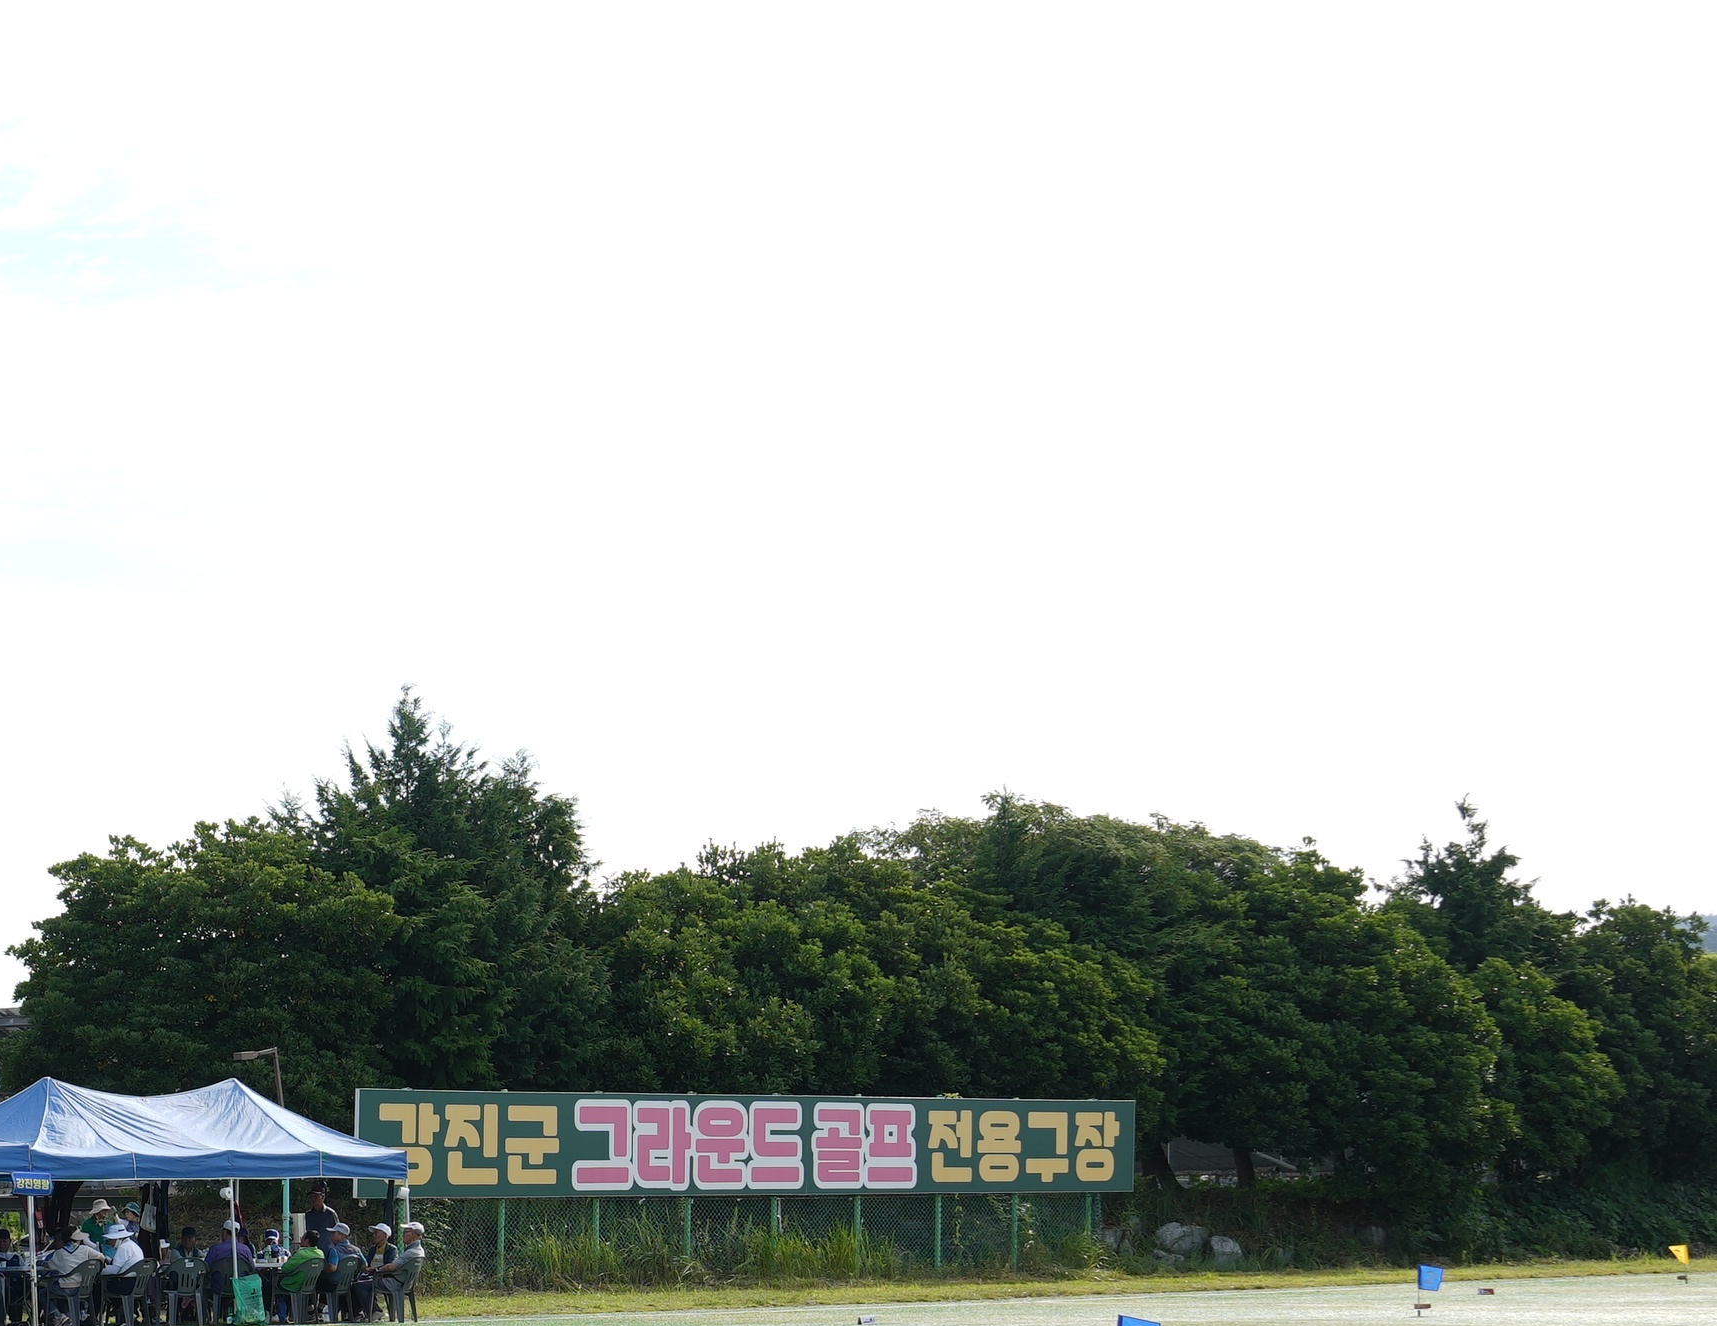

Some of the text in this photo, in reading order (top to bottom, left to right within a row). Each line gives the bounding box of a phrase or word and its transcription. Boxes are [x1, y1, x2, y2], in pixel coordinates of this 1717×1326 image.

[379, 1100, 1120, 1190] 강진군 그라운드 골프 전용구장
